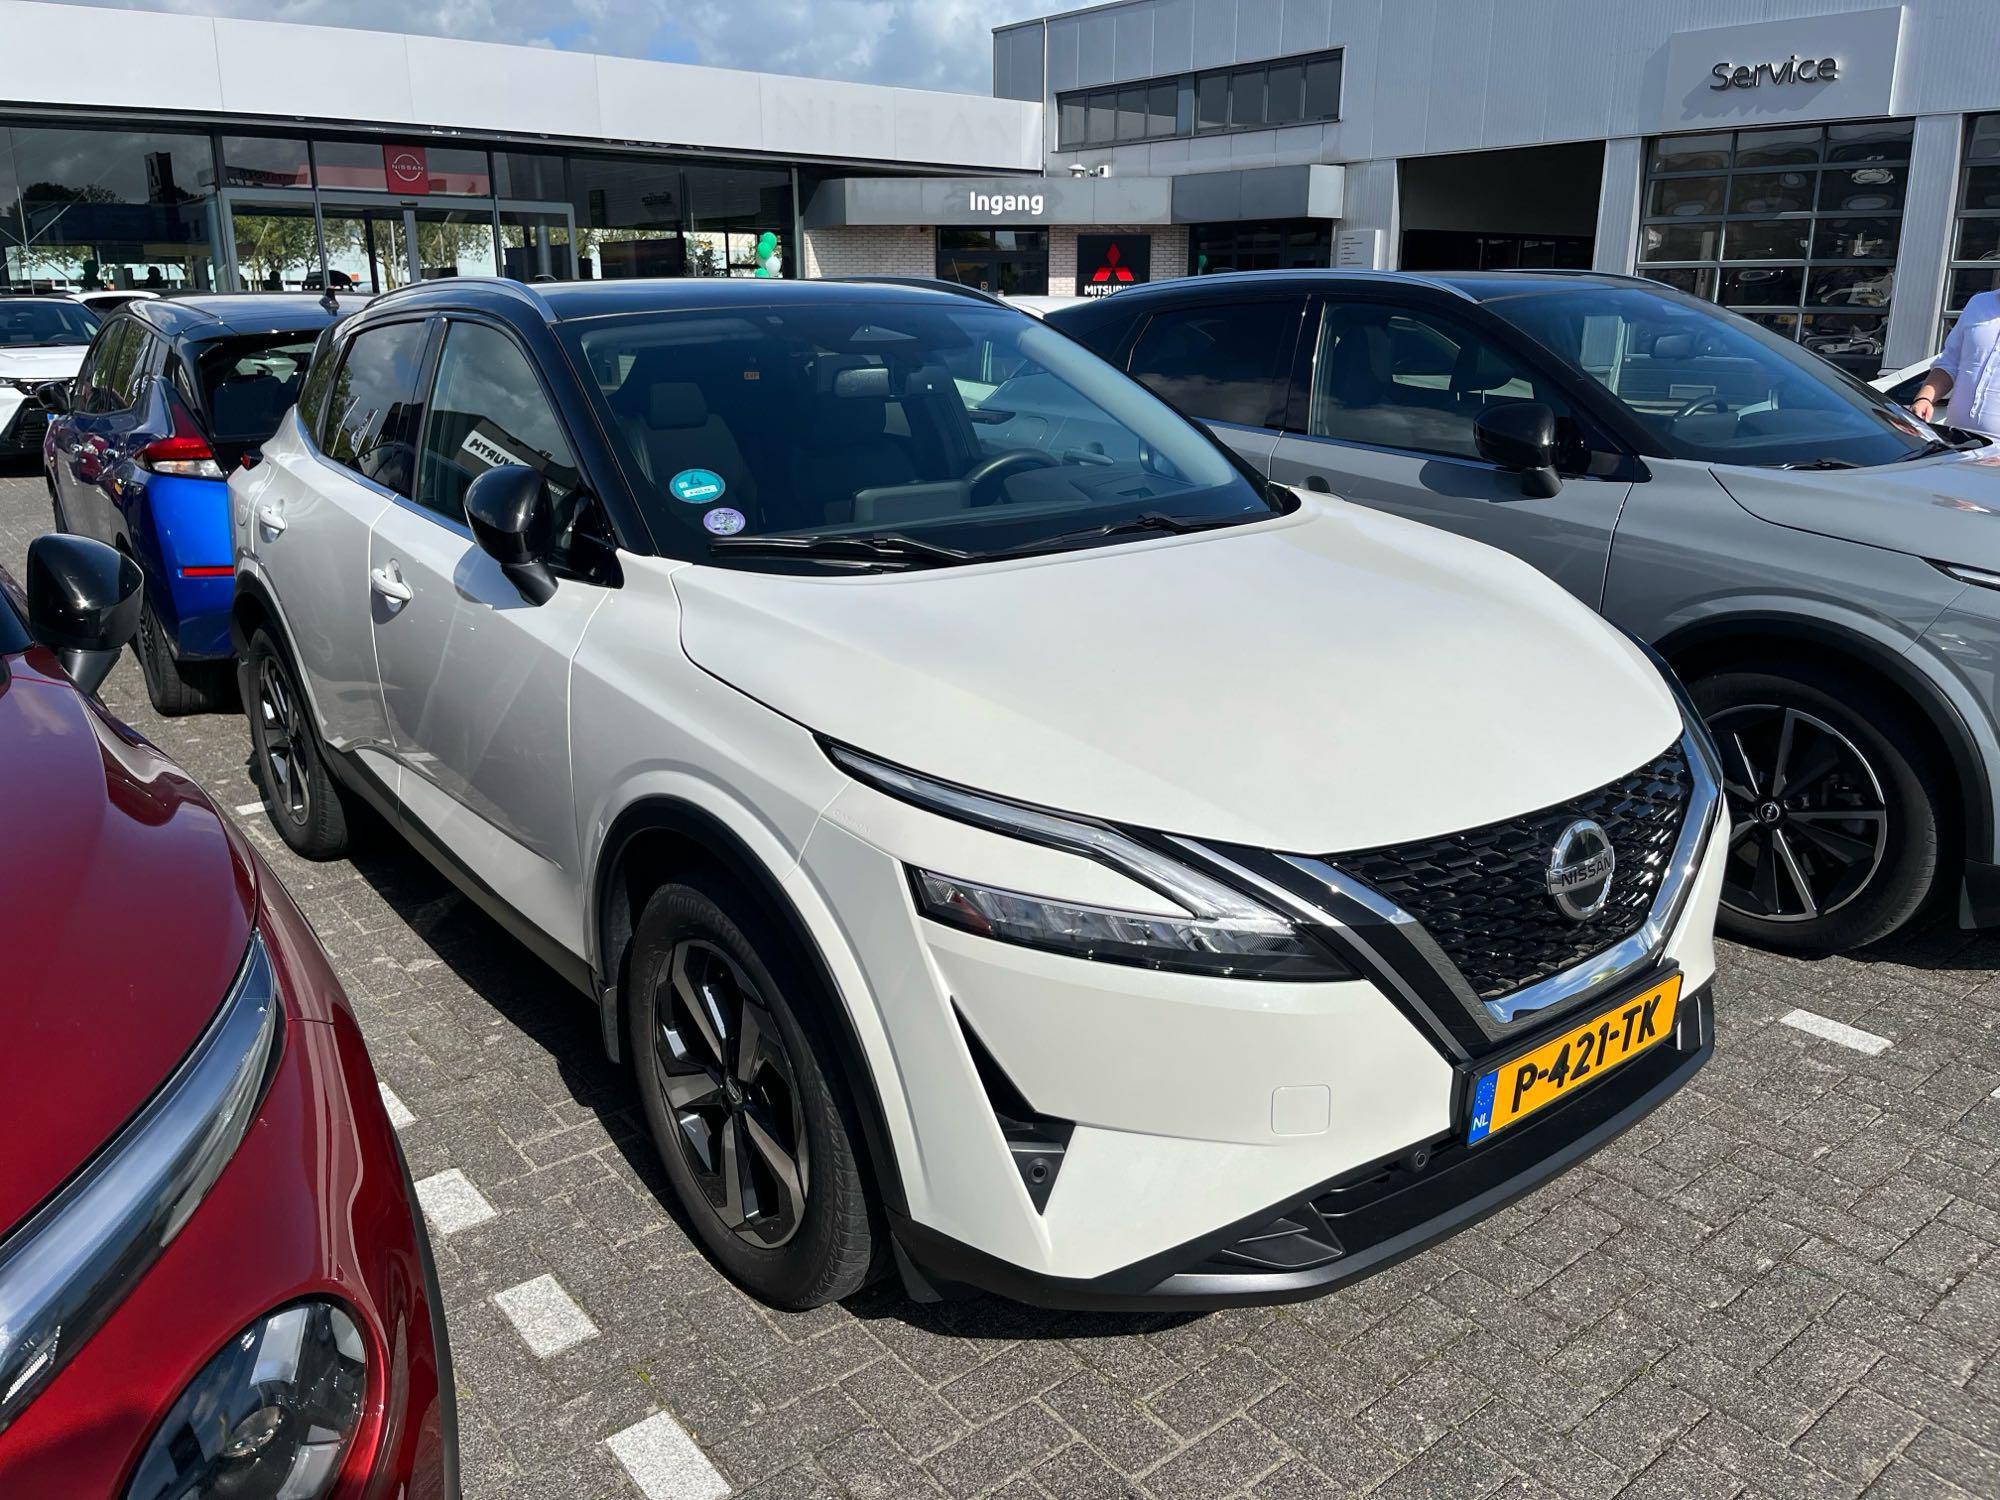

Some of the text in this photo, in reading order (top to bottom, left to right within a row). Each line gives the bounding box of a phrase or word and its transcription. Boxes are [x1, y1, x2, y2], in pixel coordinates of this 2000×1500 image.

[1710, 54, 1840, 91] Service
[969, 191, 1044, 215] Ingang
[1561, 856, 1612, 887] NISSAN
[1511, 994, 1662, 1114] P-421-TK
[1472, 1112, 1489, 1131] NL
